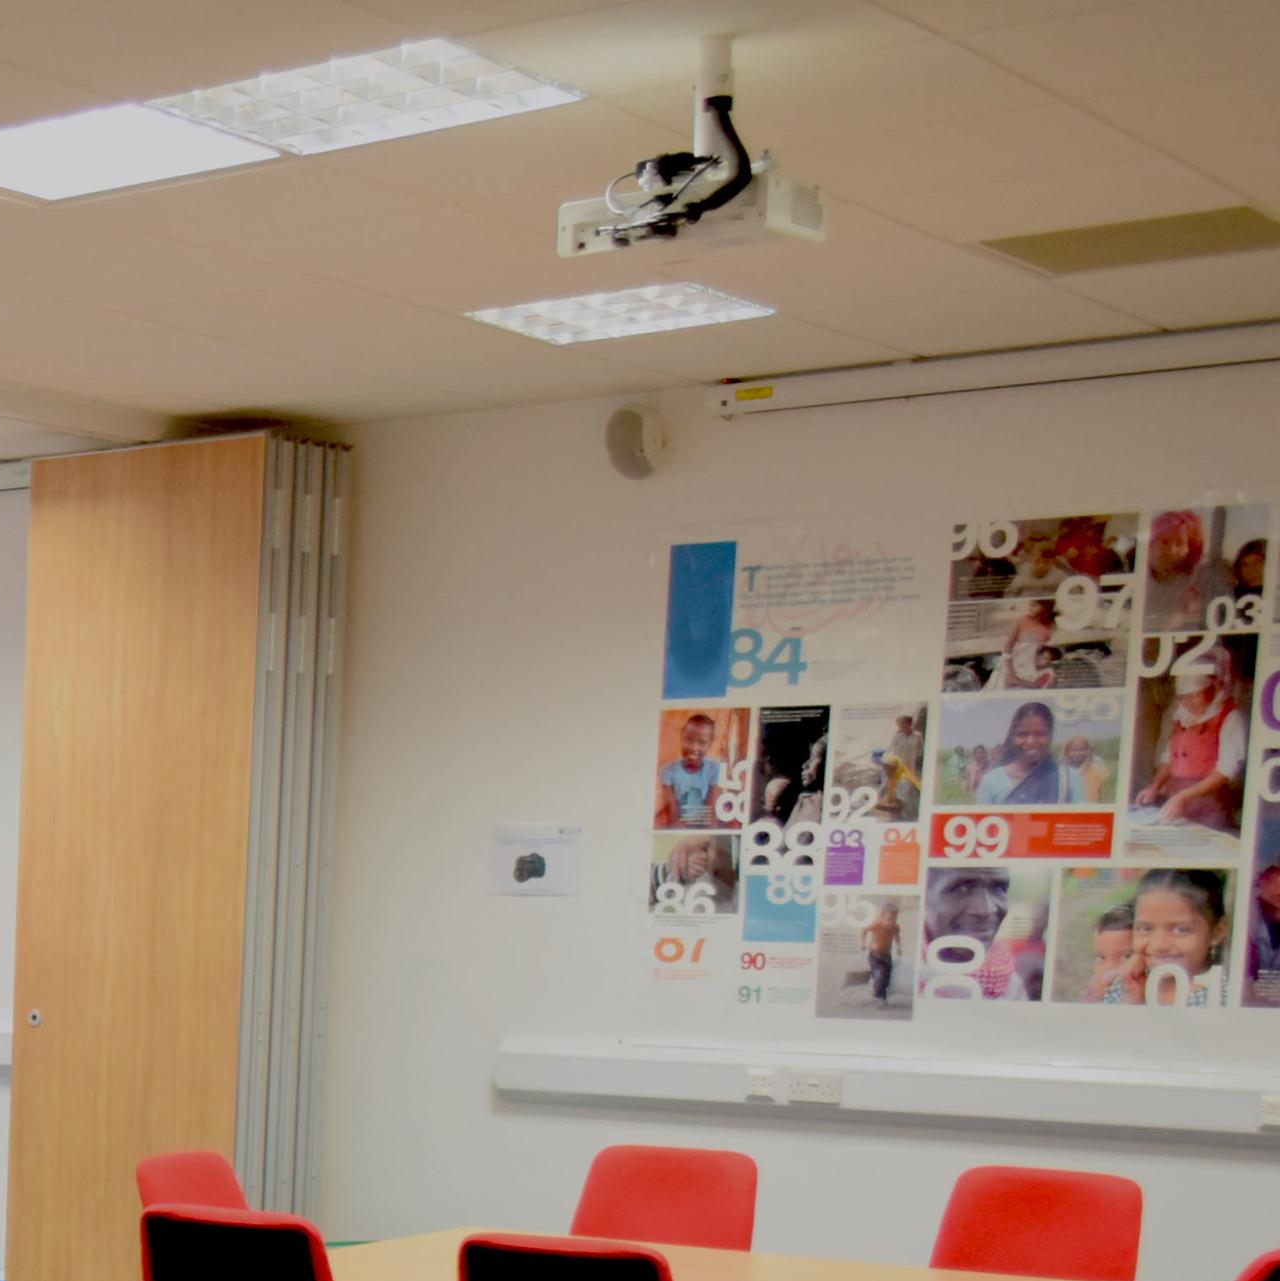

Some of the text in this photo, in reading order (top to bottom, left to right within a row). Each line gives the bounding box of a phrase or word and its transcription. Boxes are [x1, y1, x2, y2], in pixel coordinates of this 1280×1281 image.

[728, 627, 807, 689] 84
[828, 786, 878, 822] 92
[829, 829, 864, 848] 93
[943, 816, 1011, 859] 99
[740, 952, 766, 970] 90
[739, 985, 762, 1004] 91
